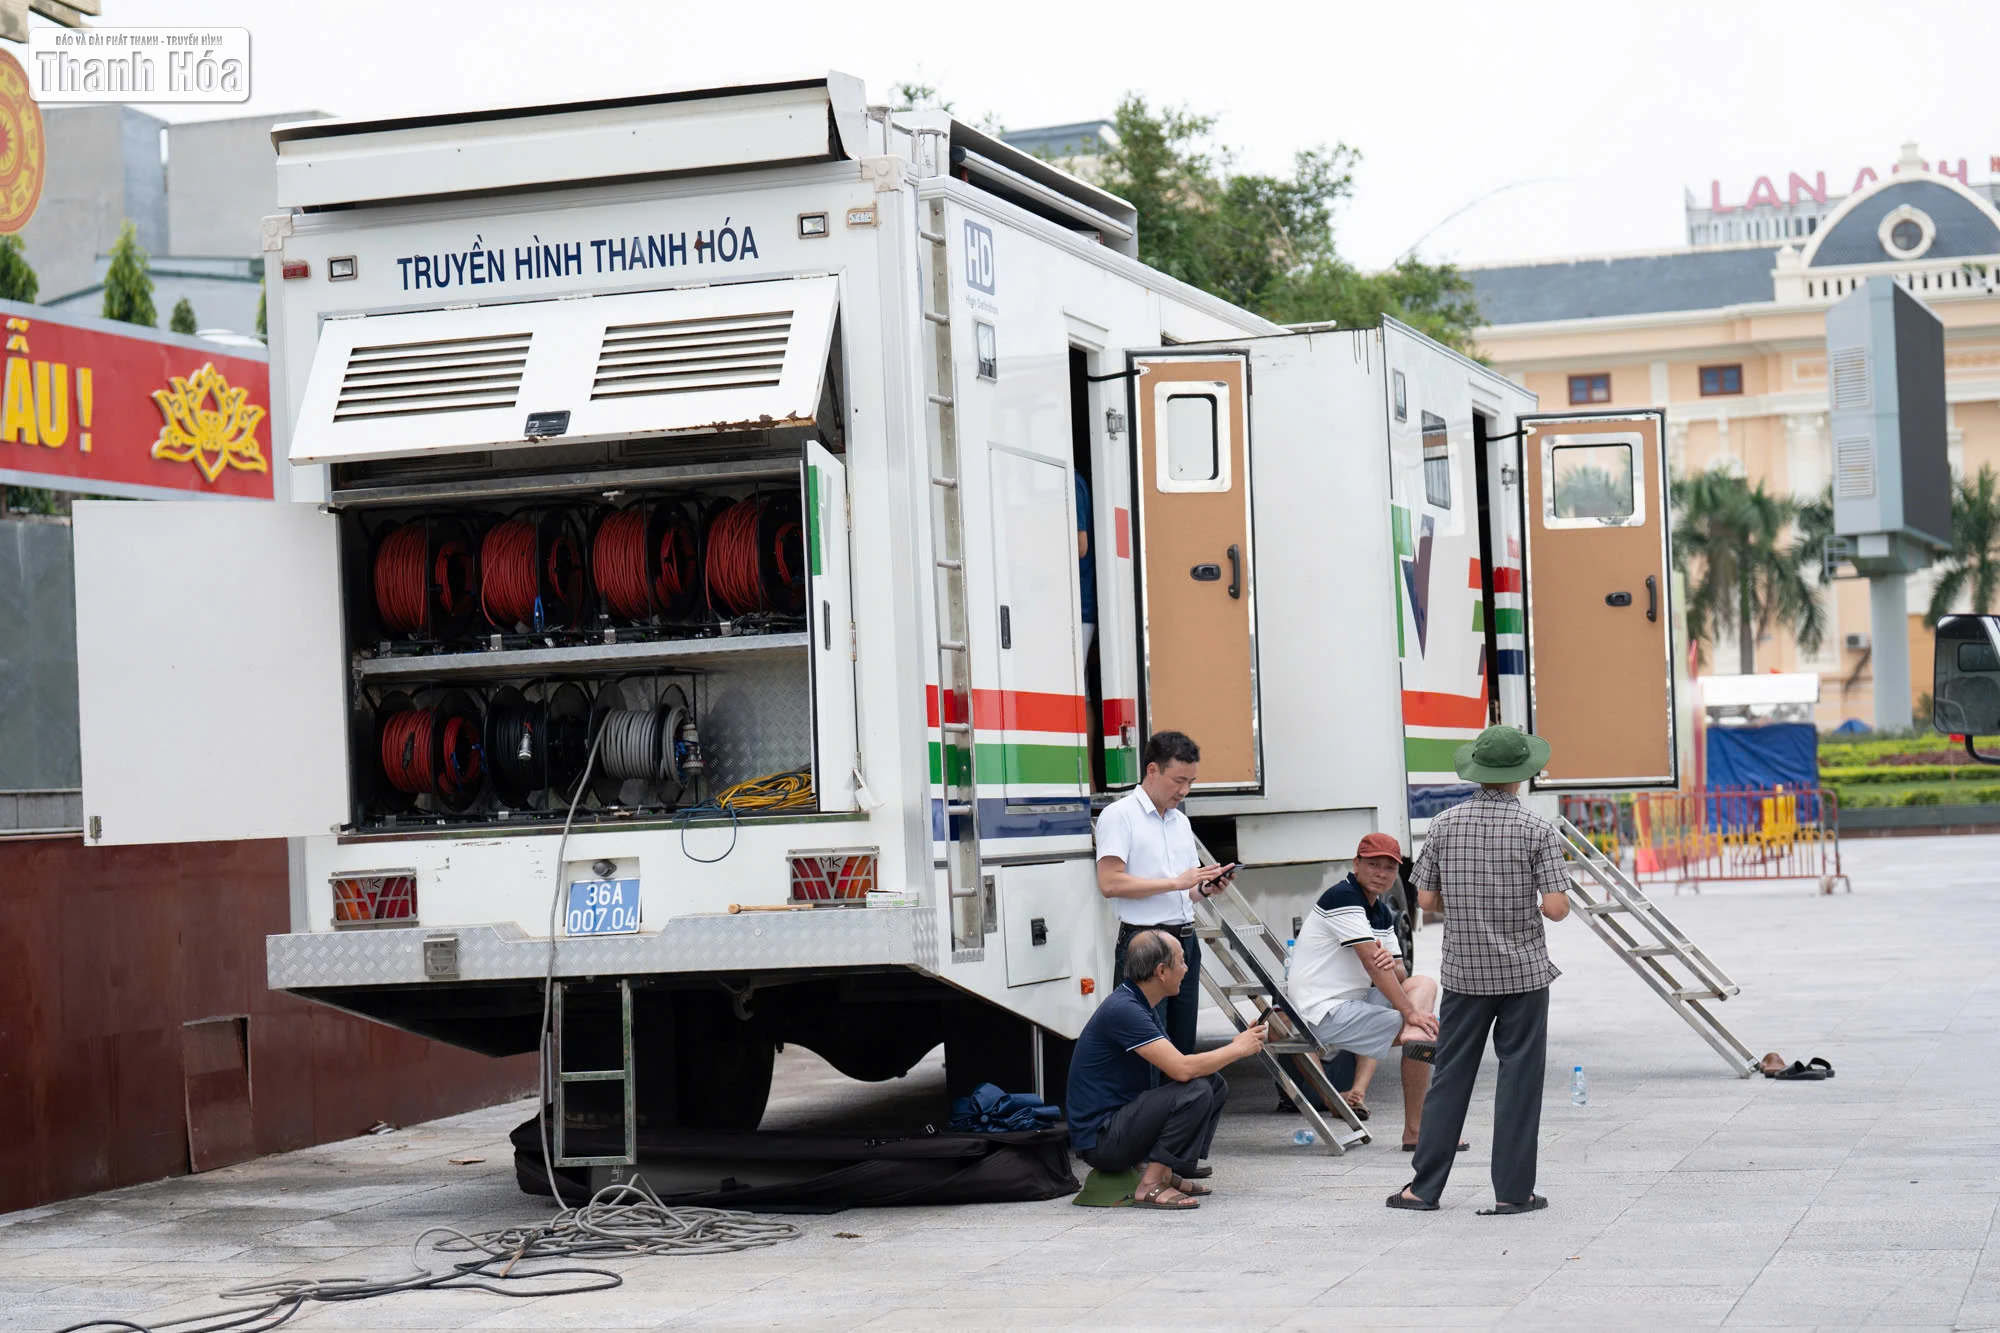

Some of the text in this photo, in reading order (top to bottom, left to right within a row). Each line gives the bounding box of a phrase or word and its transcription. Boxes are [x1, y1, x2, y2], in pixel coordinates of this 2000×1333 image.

[1711, 172, 1827, 213] LAN
[396, 216, 760, 291] TRUYỀN HÌNH THANH HÓA
[966, 226, 993, 287] HD
[819, 856, 842, 869] MK
[360, 878, 381, 890] MK
[585, 881, 623, 906] 36A
[569, 906, 637, 933] 007.04
